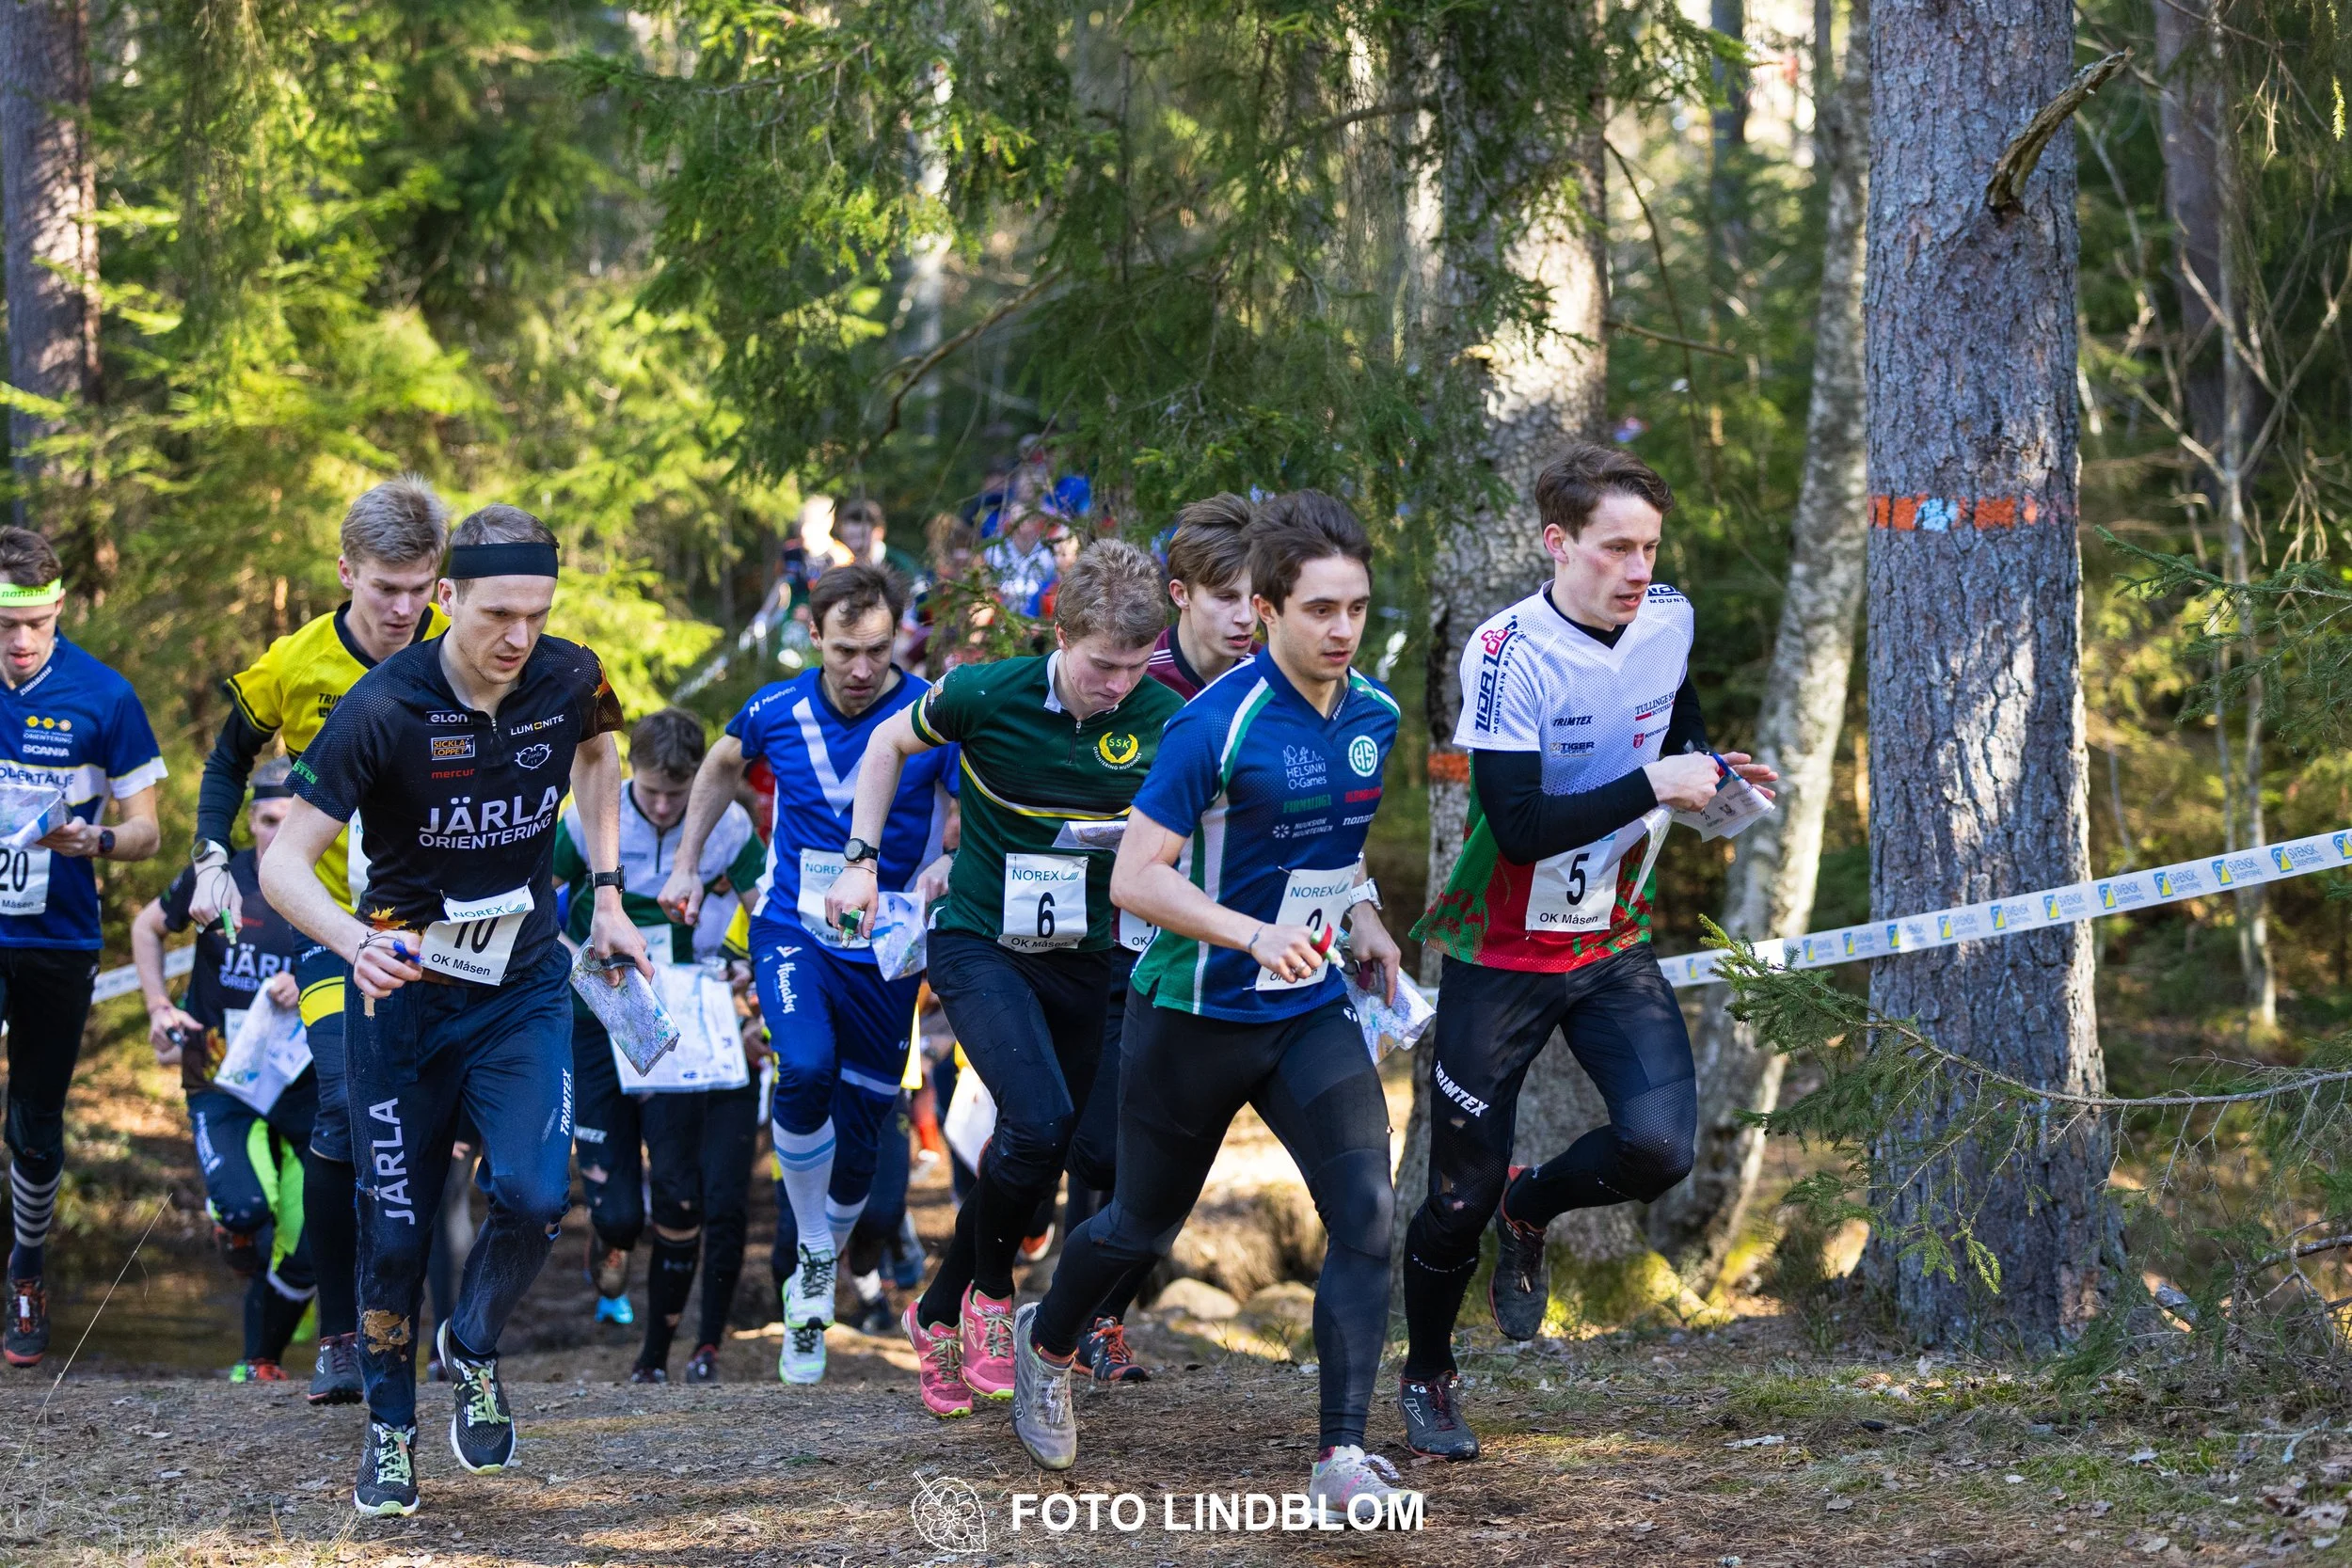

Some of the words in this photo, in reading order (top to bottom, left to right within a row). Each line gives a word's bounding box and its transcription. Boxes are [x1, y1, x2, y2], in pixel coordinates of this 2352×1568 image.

[1493, 672, 1507, 735] MOUNTAIN
[1552, 715, 1593, 727] TRIMTEX
[23, 744, 70, 757] SCANIA
[434, 739, 466, 748] SICKLA
[1109, 738, 1131, 749] SSK
[1561, 741, 1595, 752] TIGER
[433, 748, 466, 756] LOPPET
[431, 768, 474, 780] mercur
[1286, 762, 1327, 779] HELSINKI
[1289, 776, 1327, 790] O-Games
[419, 785, 559, 835] JÄRLA
[419, 813, 552, 849] ORIENTERING
[2287, 843, 2319, 860] SVENSK
[2228, 857, 2258, 872] SVENSK
[1011, 869, 1059, 881] NOREX
[1566, 852, 1590, 906] 5
[2169, 869, 2198, 886] SVENSK
[1290, 885, 1335, 898] NOREX
[2113, 881, 2141, 897] SVENSK
[453, 905, 505, 918] NOREX
[1037, 892, 1056, 939] 6
[1539, 912, 1559, 923] OK
[1561, 913, 1598, 925] Måsen
[453, 916, 501, 954] 10
[1011, 937, 1030, 948] OK
[431, 953, 451, 967] OK
[453, 958, 491, 976] Måsen
[1435, 1059, 1489, 1117] TRIMTEX
[559, 1068, 572, 1136] TRIMTEX
[369, 1098, 416, 1226] JÄRLA
